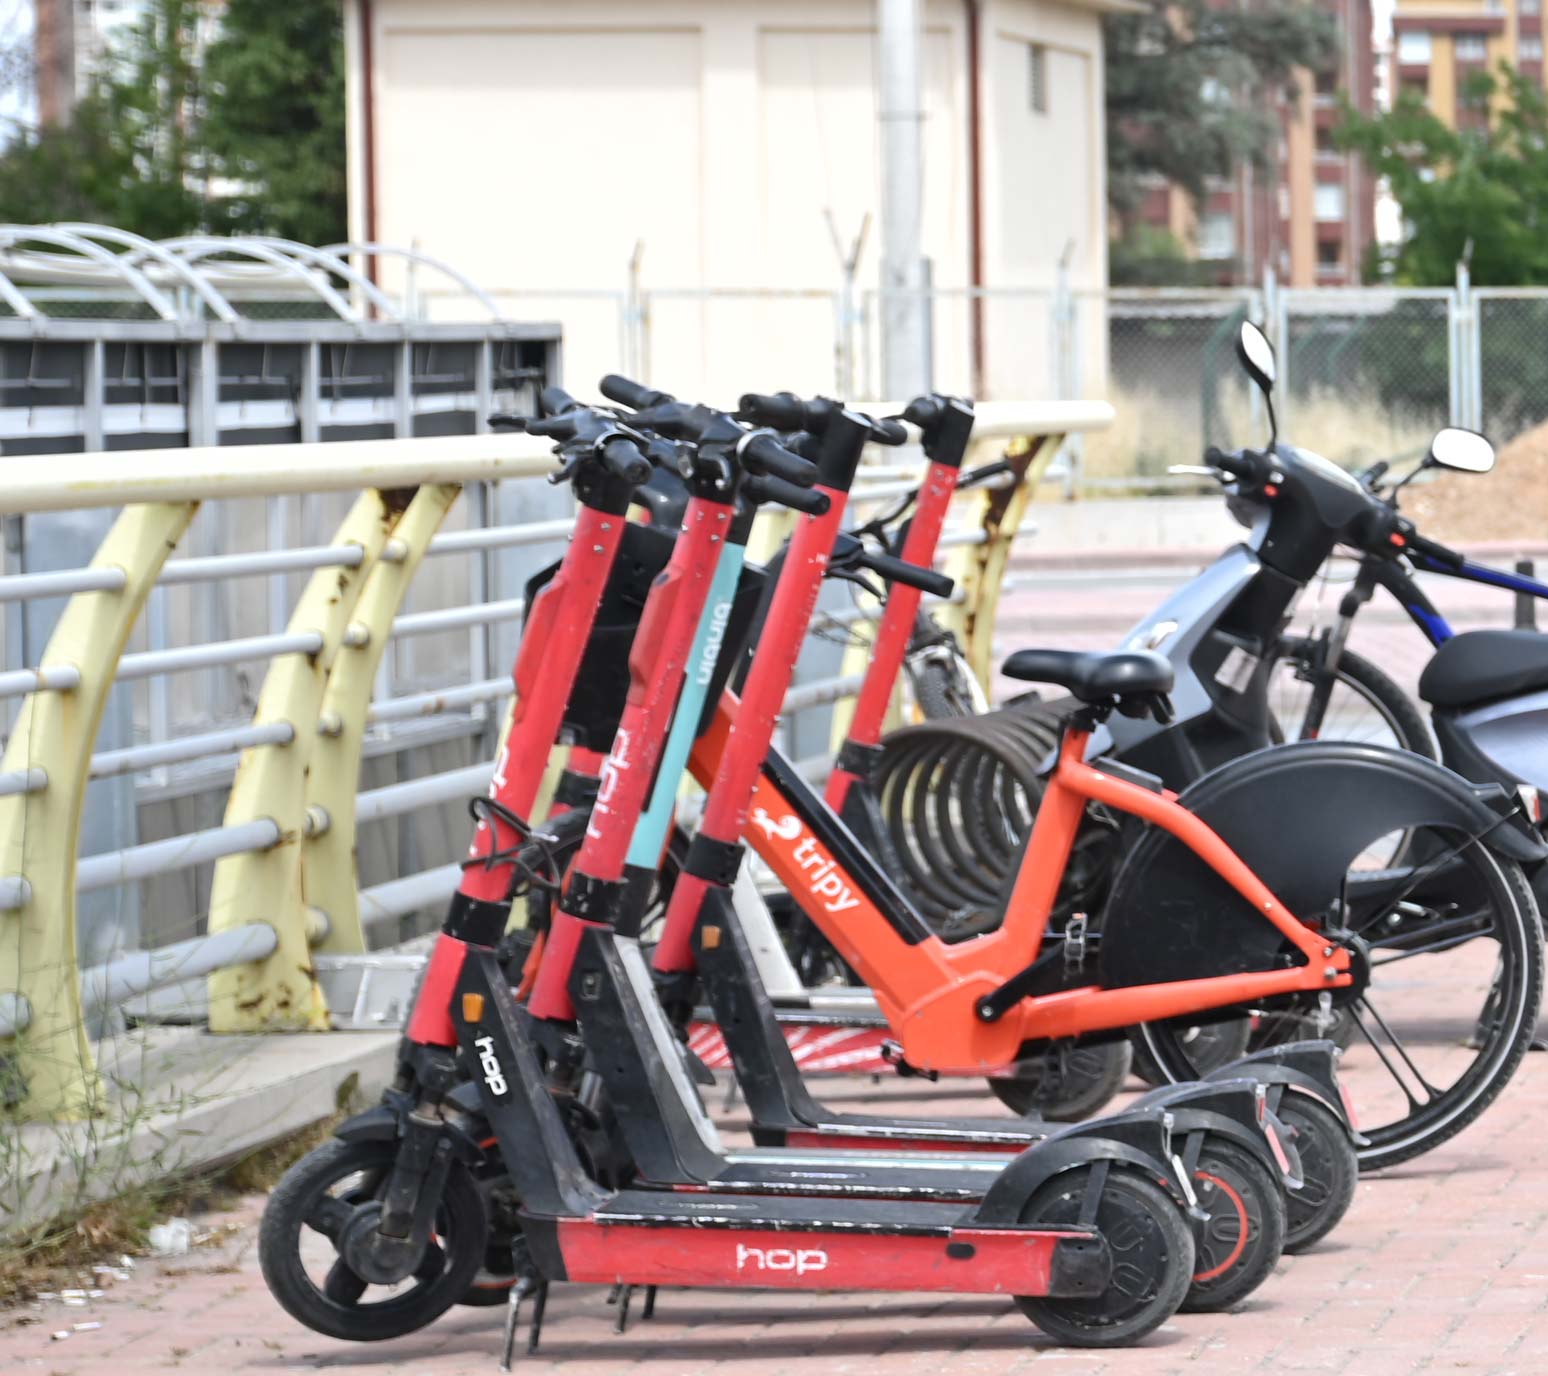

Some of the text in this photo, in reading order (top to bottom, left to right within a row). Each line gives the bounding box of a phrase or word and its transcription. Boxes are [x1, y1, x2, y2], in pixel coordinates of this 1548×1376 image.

[792, 836, 861, 912] tripy
[474, 1036, 508, 1096] hop
[736, 1243, 829, 1275] hop
